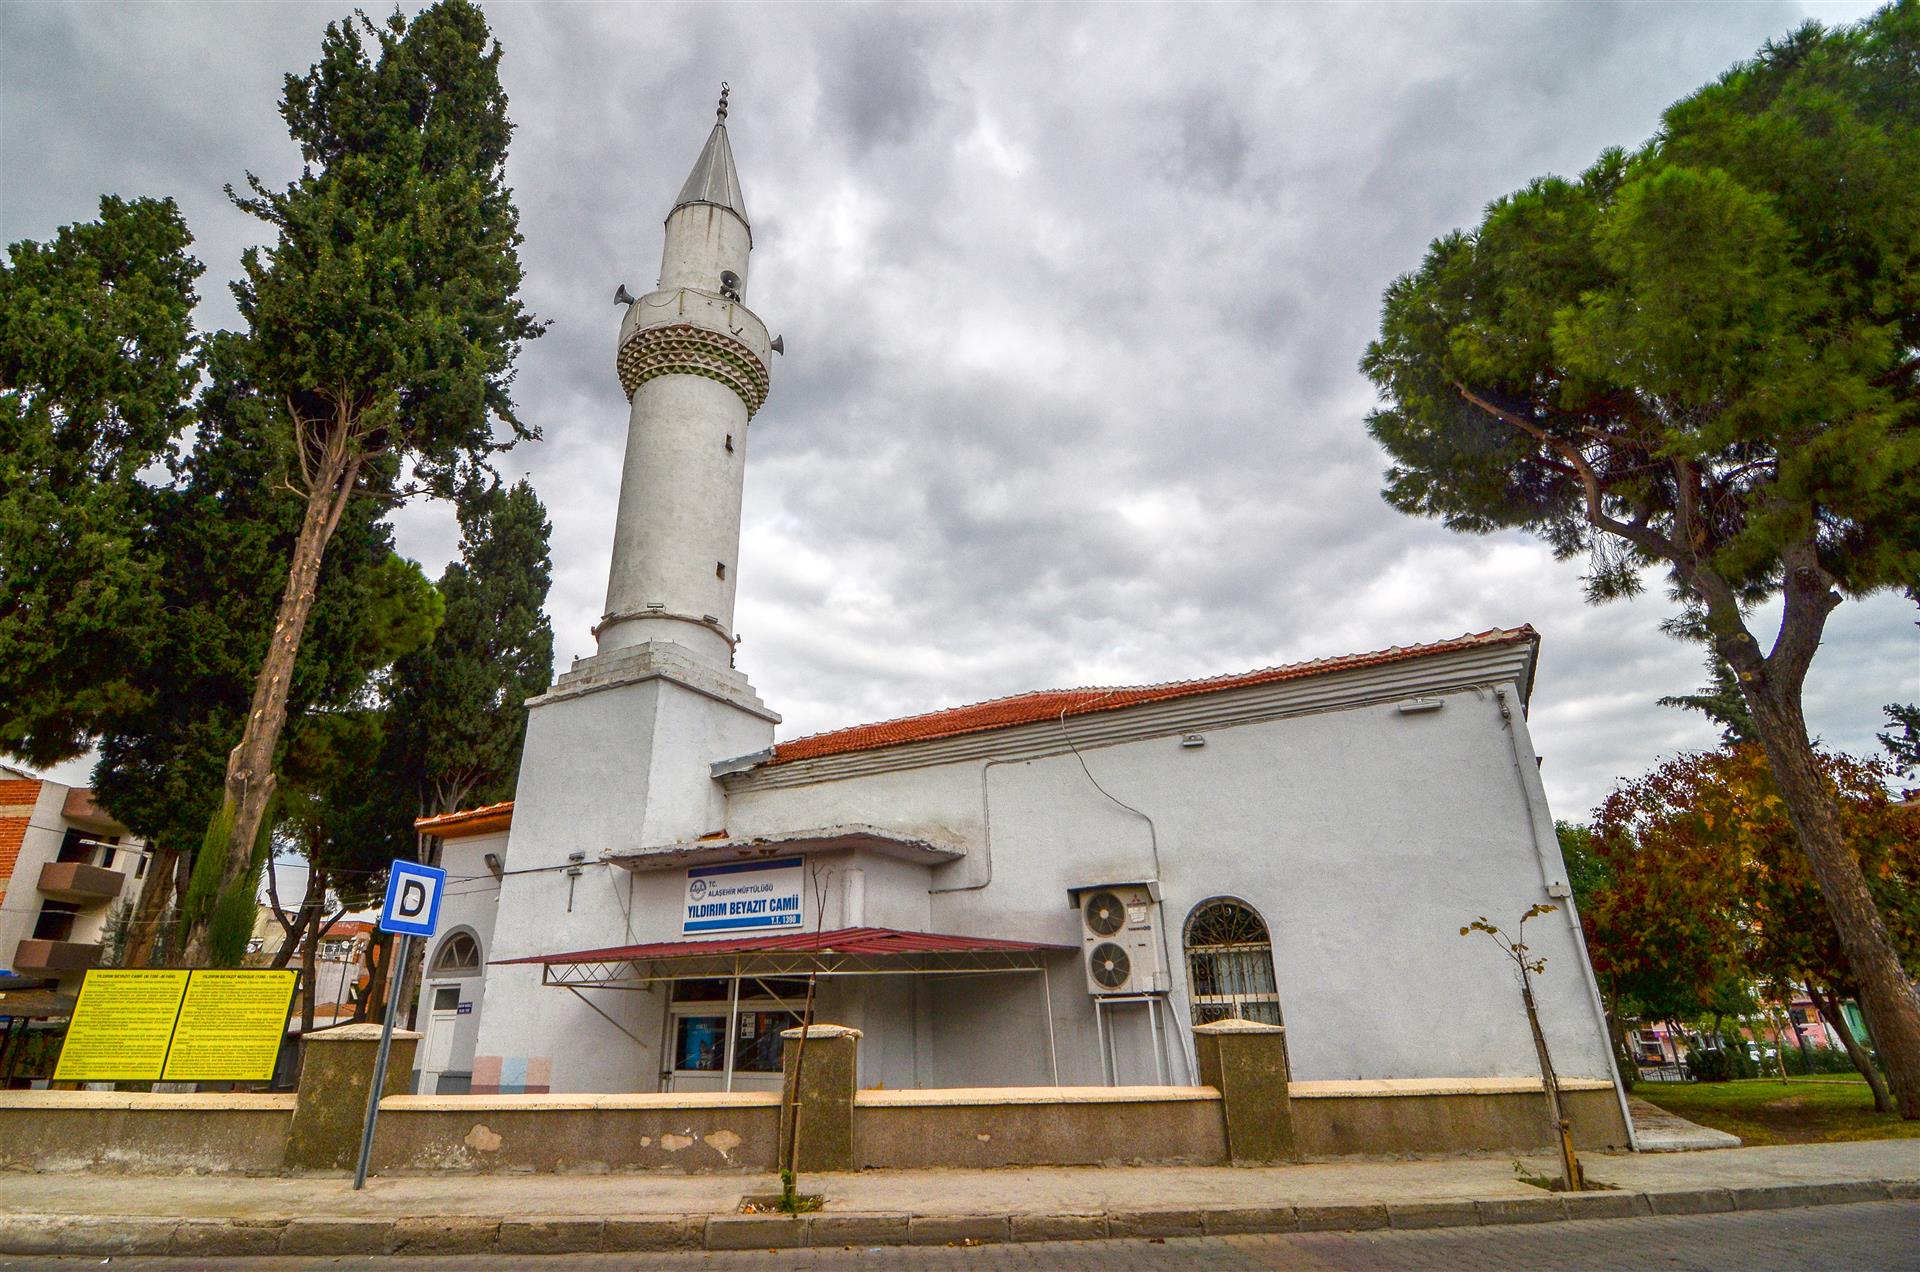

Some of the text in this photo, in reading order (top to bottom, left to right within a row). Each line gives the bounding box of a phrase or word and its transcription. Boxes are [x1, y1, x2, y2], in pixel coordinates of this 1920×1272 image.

[399, 879, 426, 917] D
[708, 883, 774, 898] ALAŞEHİR MÜFTÜLÜĞÜ
[688, 894, 799, 918] YILDIRIM BEYAZIT CAMİİ
